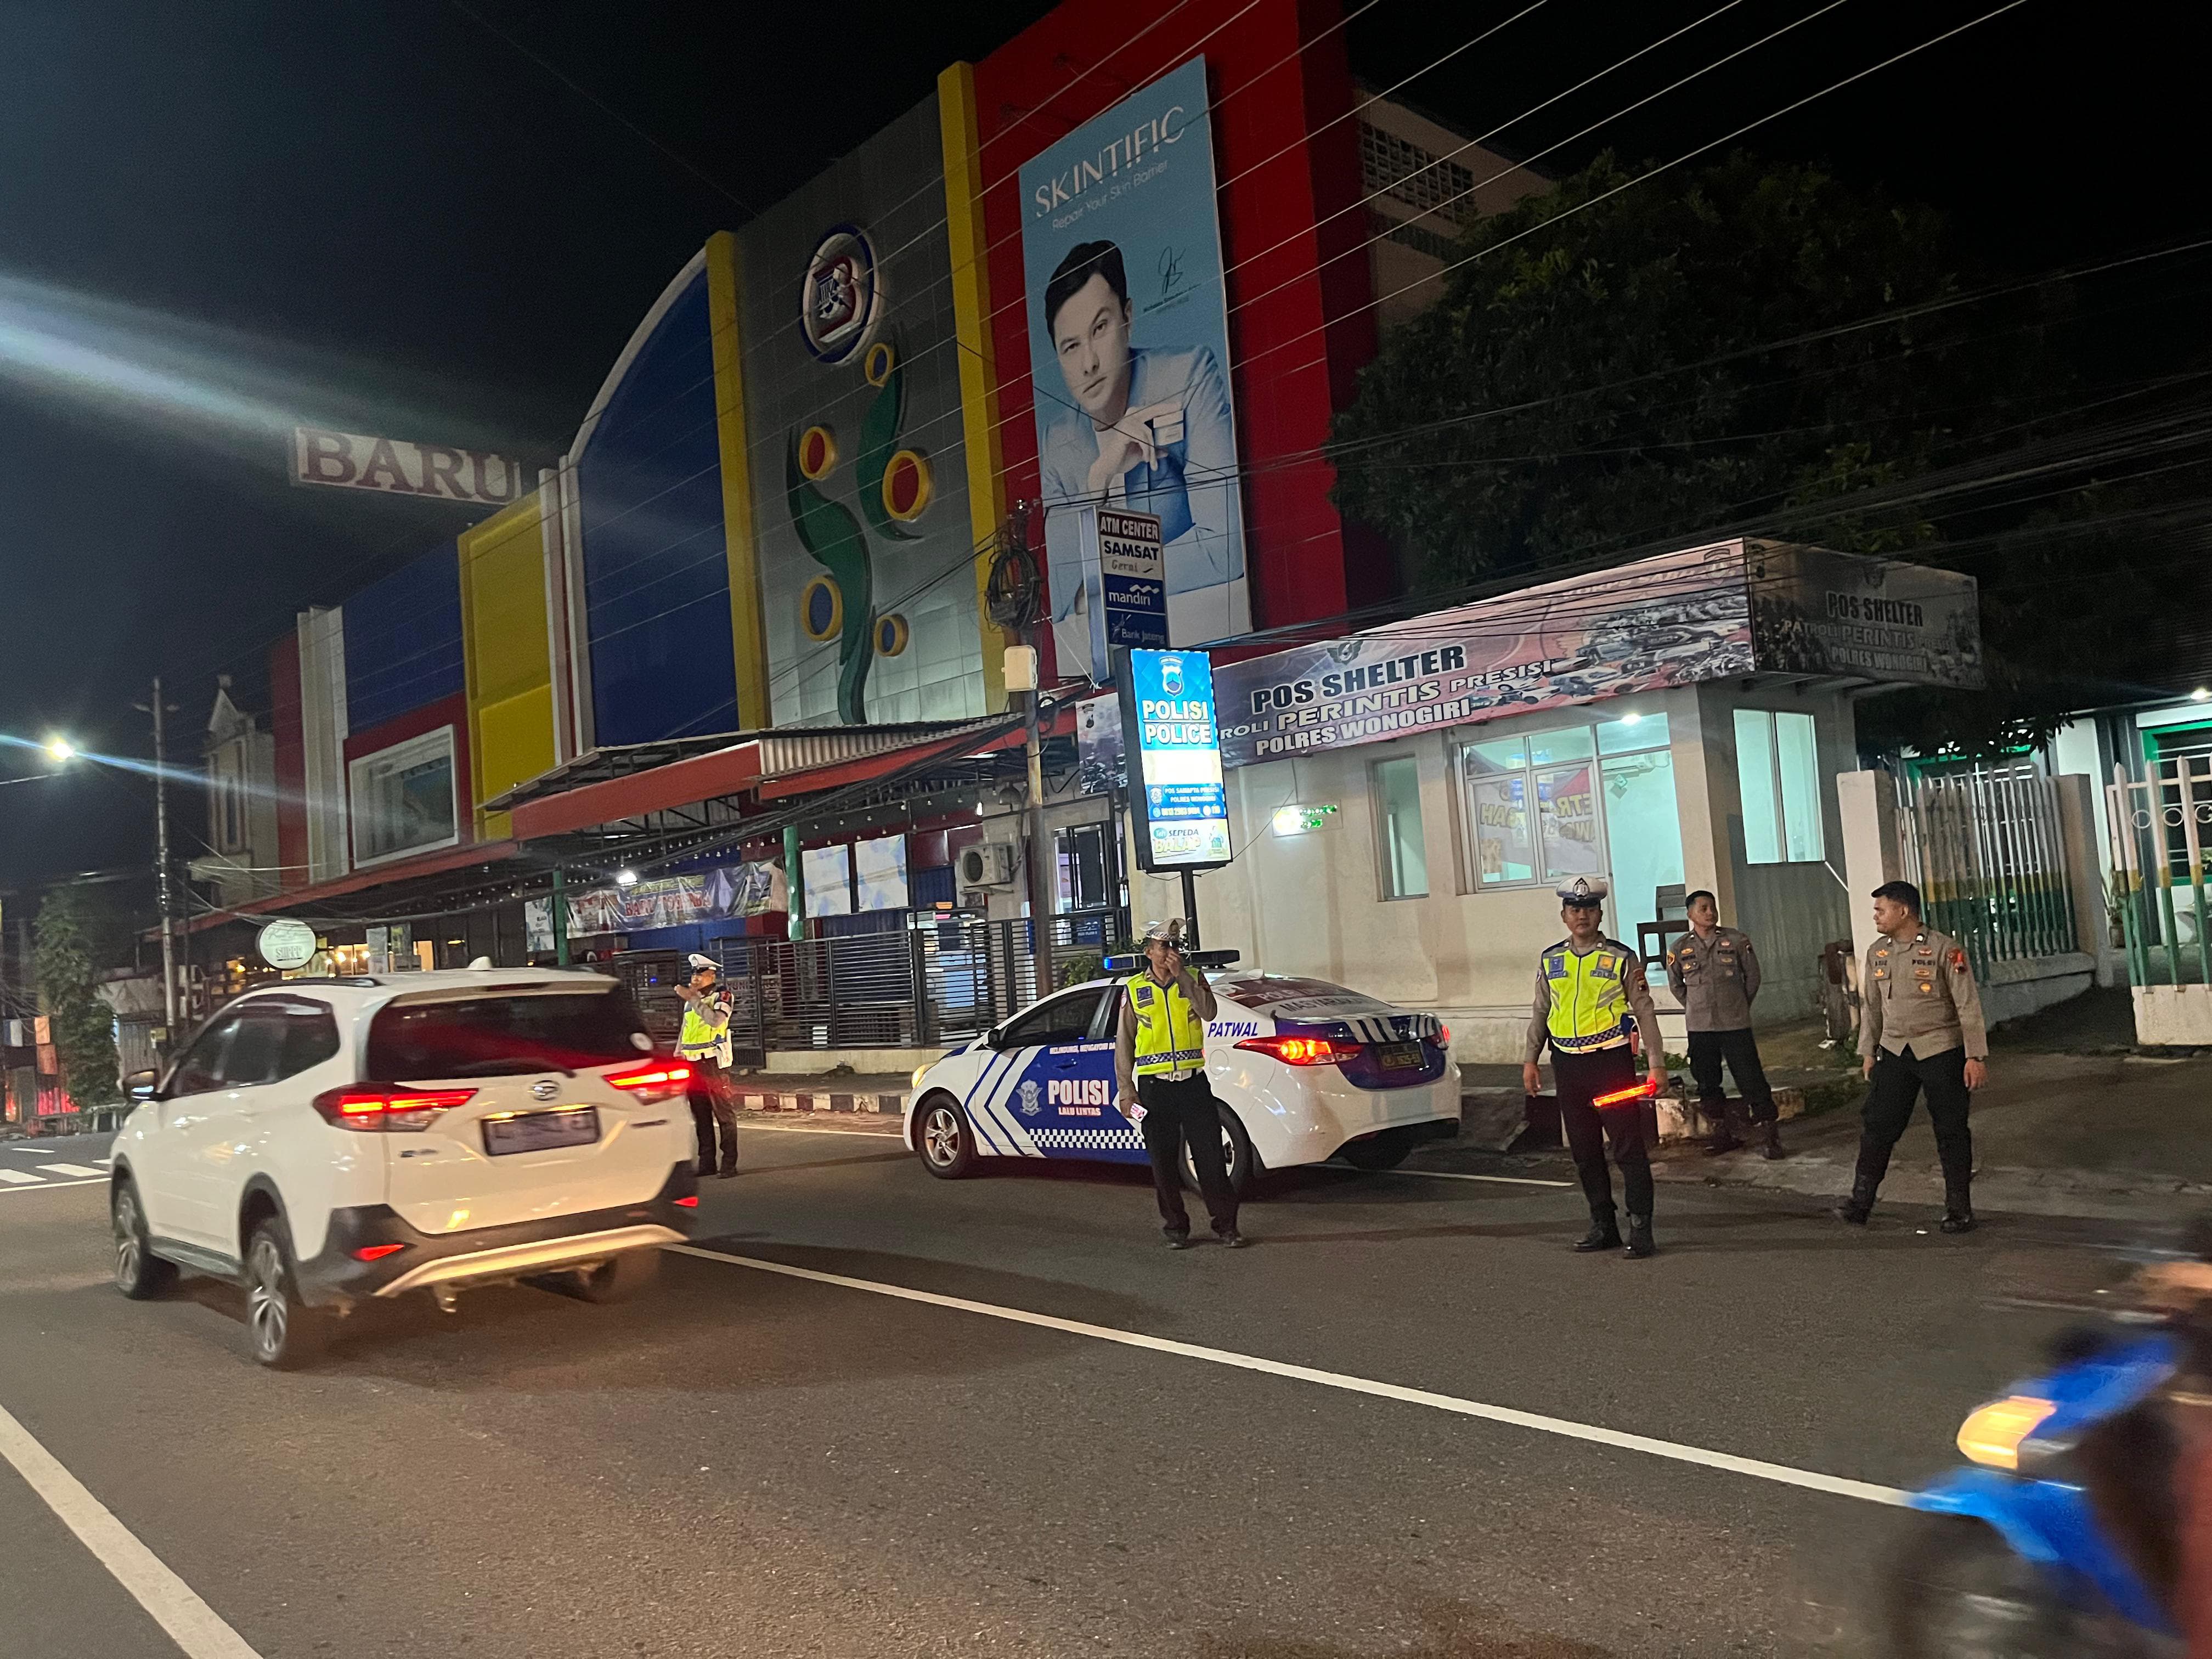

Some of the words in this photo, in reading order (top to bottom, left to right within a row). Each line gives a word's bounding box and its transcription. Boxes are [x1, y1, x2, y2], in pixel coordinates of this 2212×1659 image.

[1035, 106, 1184, 218] SKINTIFIC
[1086, 194, 1108, 213] Your
[1110, 182, 1131, 201] Skin
[298, 428, 516, 502] BARU
[1100, 517, 1119, 534] ATM
[1122, 520, 1159, 540] CENTER
[1104, 540, 1159, 561] SAMSAT
[1109, 590, 1150, 606] mandiri
[1826, 590, 1859, 620] POS
[1863, 597, 1924, 628] SHELTER
[1121, 628, 1140, 640] Bank
[1783, 619, 1839, 638] PATROLI
[1841, 625, 1916, 650] PERINTIS
[1831, 646, 1872, 668] POLRES
[1874, 652, 1928, 673] WONOGIRI
[1251, 679, 1315, 714] POS
[1322, 644, 1467, 699] SHELTER
[1142, 699, 1209, 721] POLISI
[1220, 719, 1269, 742] ROLI
[1277, 680, 1441, 731] PERINTIS
[1449, 659, 1553, 694] PRESISI
[1144, 723, 1212, 744] POLICE
[1255, 726, 1338, 757] POLRES
[1340, 697, 1473, 739] WONOGIRI
[1169, 828, 1199, 837] SEPEDA
[1207, 1022, 1259, 1037] PATWAL
[1048, 1079, 1110, 1105] POLISI
[1058, 1107, 1075, 1116] LALU
[1076, 1107, 1102, 1116] LINTAS
